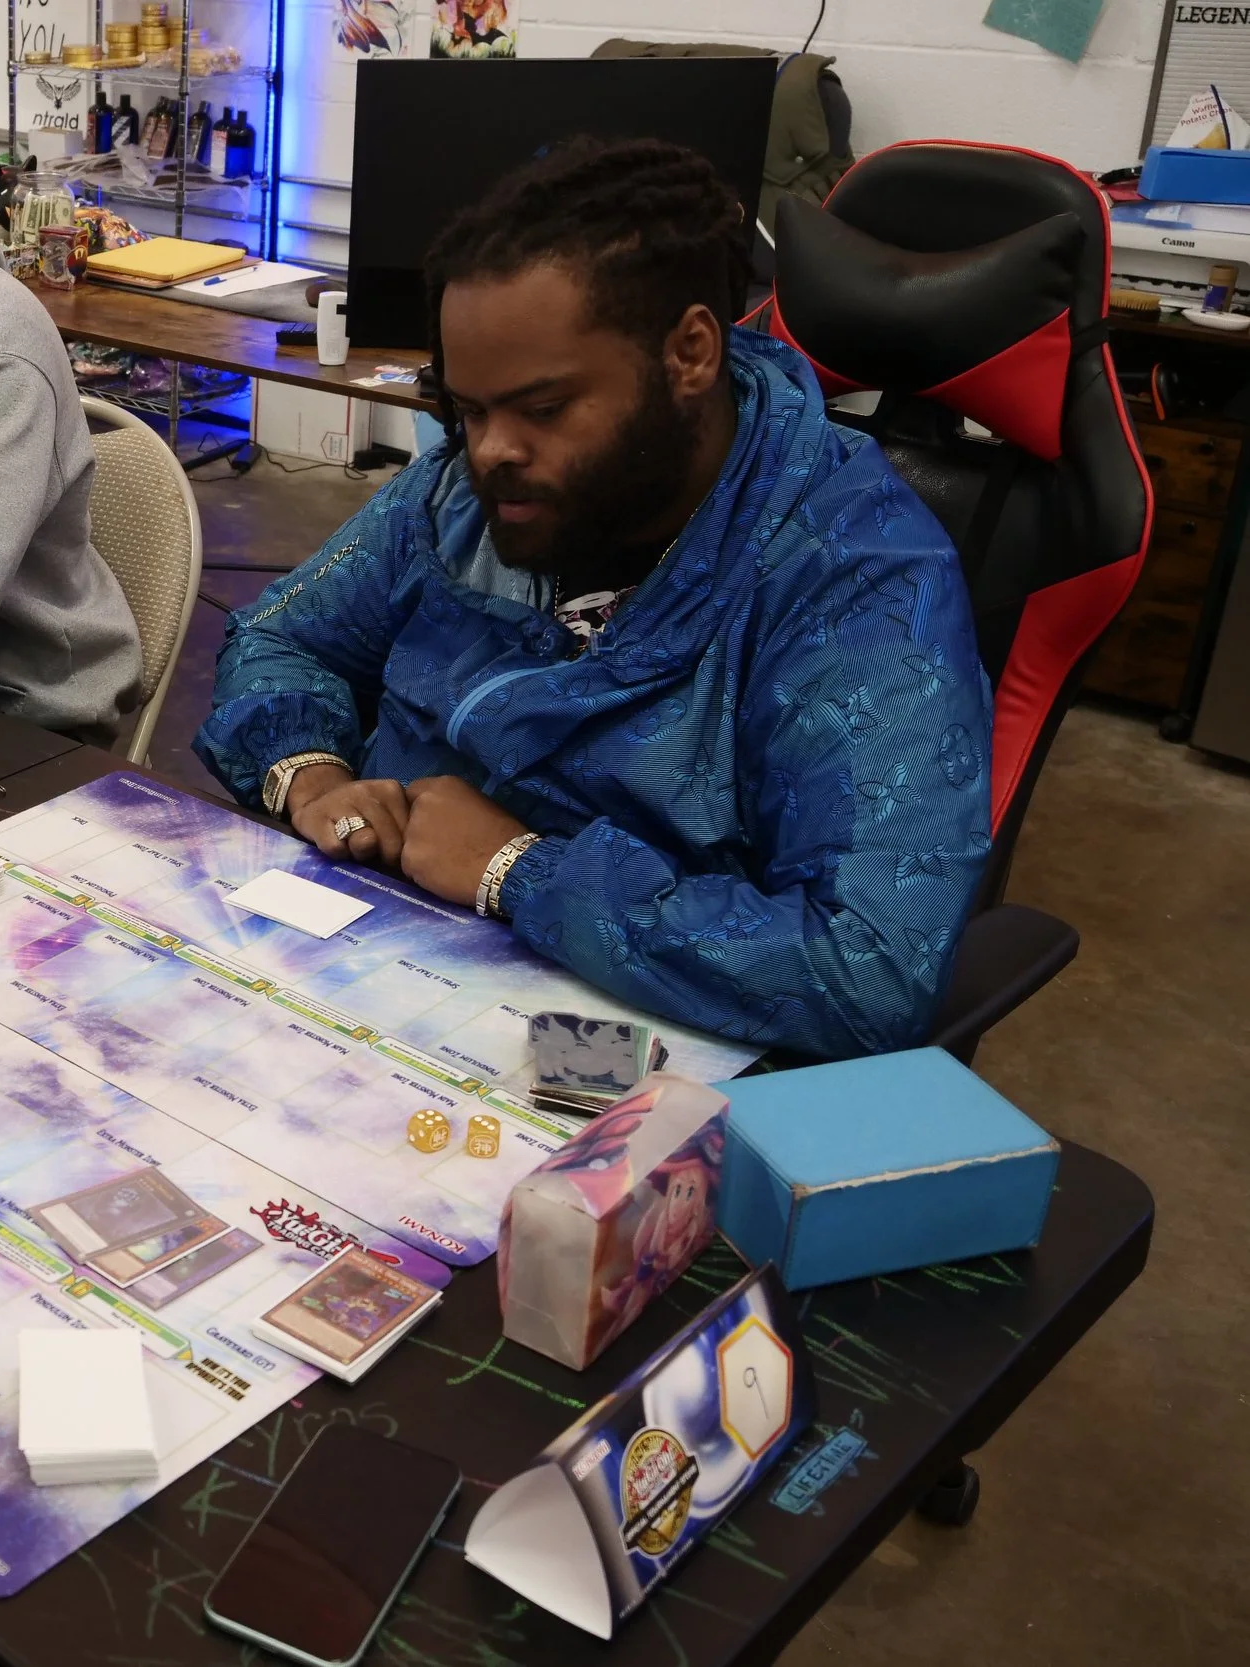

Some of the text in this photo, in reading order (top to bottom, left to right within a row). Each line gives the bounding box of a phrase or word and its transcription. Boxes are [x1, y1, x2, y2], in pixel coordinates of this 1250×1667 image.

[1175, 6, 1250, 24] LEGEN
[1192, 103, 1218, 115] Waffle
[1181, 113, 1207, 126] Potato
[1162, 237, 1195, 249] Canon
[396, 960, 417, 969] ZONE
[414, 968, 434, 976] TRAP
[438, 978, 460, 988] SPELL
[438, 1046, 460, 1056] ZONE
[457, 1055, 501, 1075] PENDULUM
[193, 1076, 211, 1086] ZONE
[208, 1085, 238, 1100] MONSTER
[389, 1073, 458, 1106] MAIN MONSTER ZONE
[512, 1133, 539, 1145] ZONE
[399, 1215, 467, 1254] KONAMI
